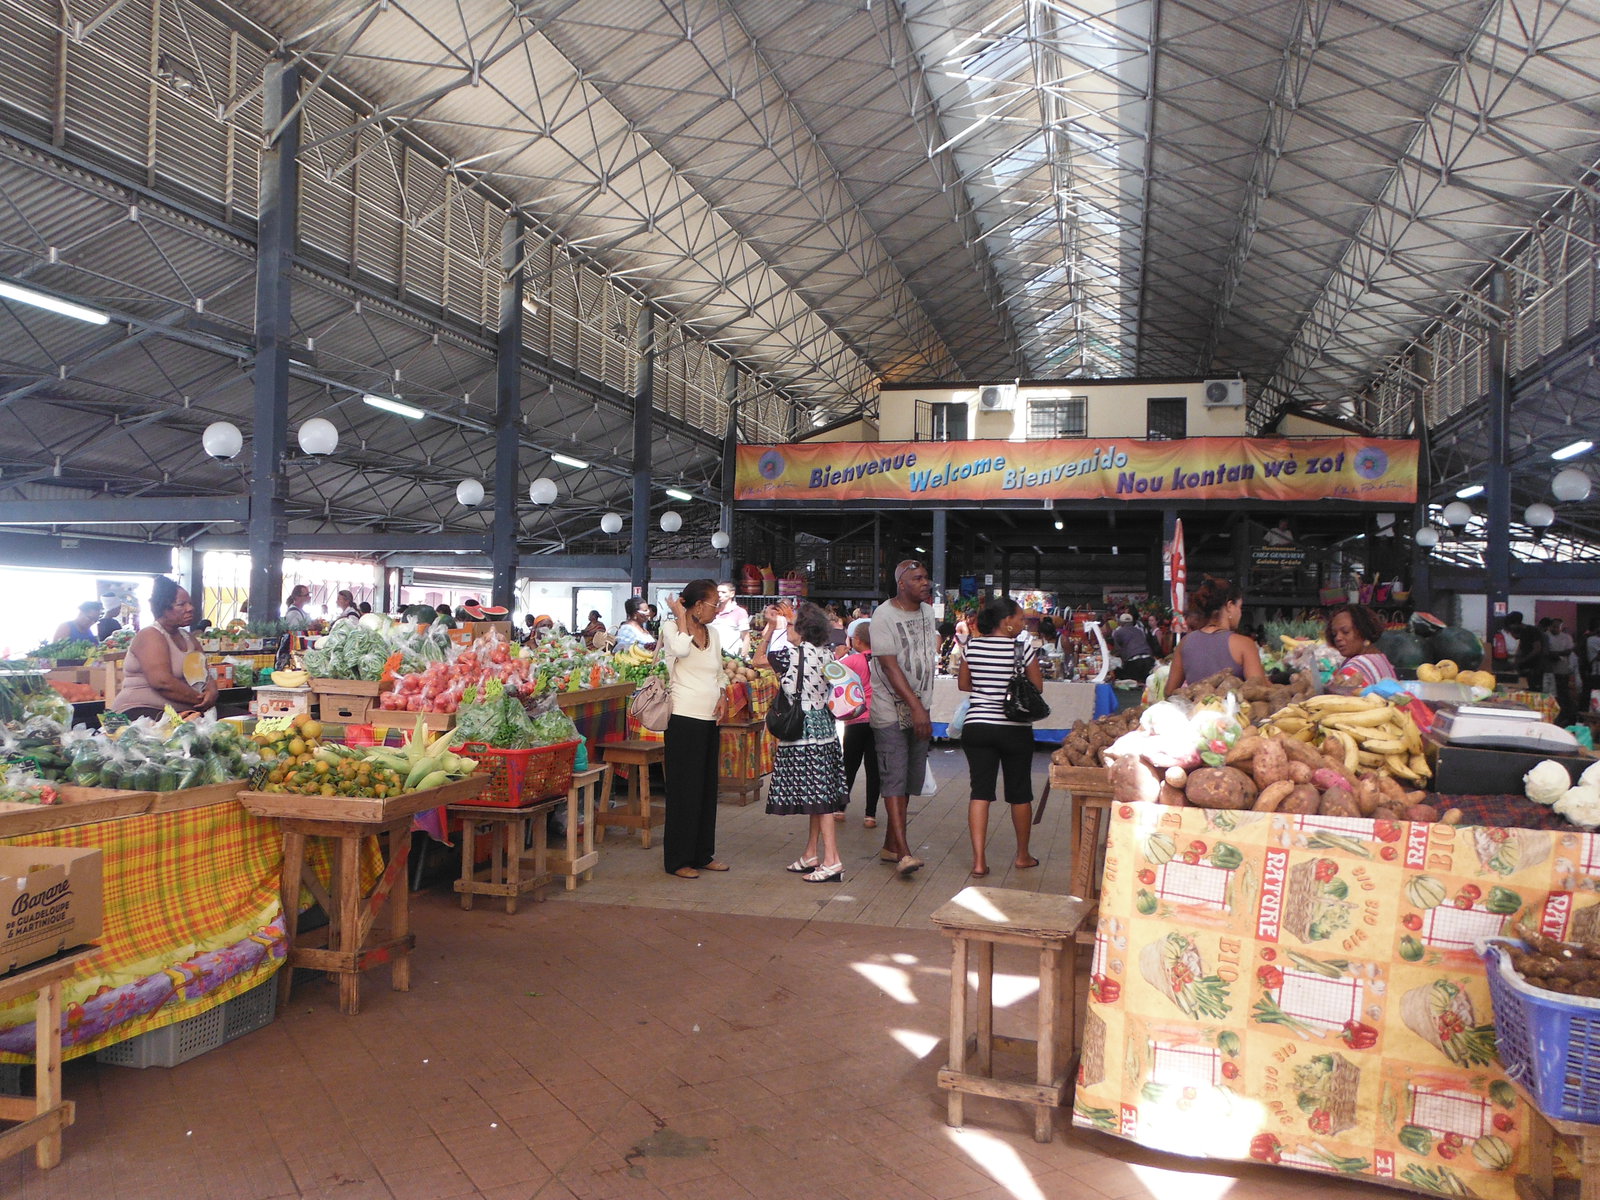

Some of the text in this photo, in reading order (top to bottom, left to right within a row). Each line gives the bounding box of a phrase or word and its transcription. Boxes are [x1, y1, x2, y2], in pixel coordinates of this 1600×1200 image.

[808, 452, 917, 489] Bienvenue
[908, 456, 1006, 493] Welcome
[1001, 445, 1128, 491] Bienvenido
[1115, 472, 1163, 494] Nou
[1171, 463, 1255, 491] kontan
[1263, 453, 1298, 479] wè
[1306, 451, 1345, 475] zot
[1428, 823, 1457, 871] BIO
[11, 879, 73, 916] Banane
[17, 901, 70, 926] GUADELOUPE
[1258, 851, 1287, 938] NATURE
[1342, 866, 1380, 951] BIO BIO BIO
[1542, 894, 1569, 942] NAT
[16, 911, 66, 937] MARTINIQUE
[1217, 936, 1241, 983] BIO
